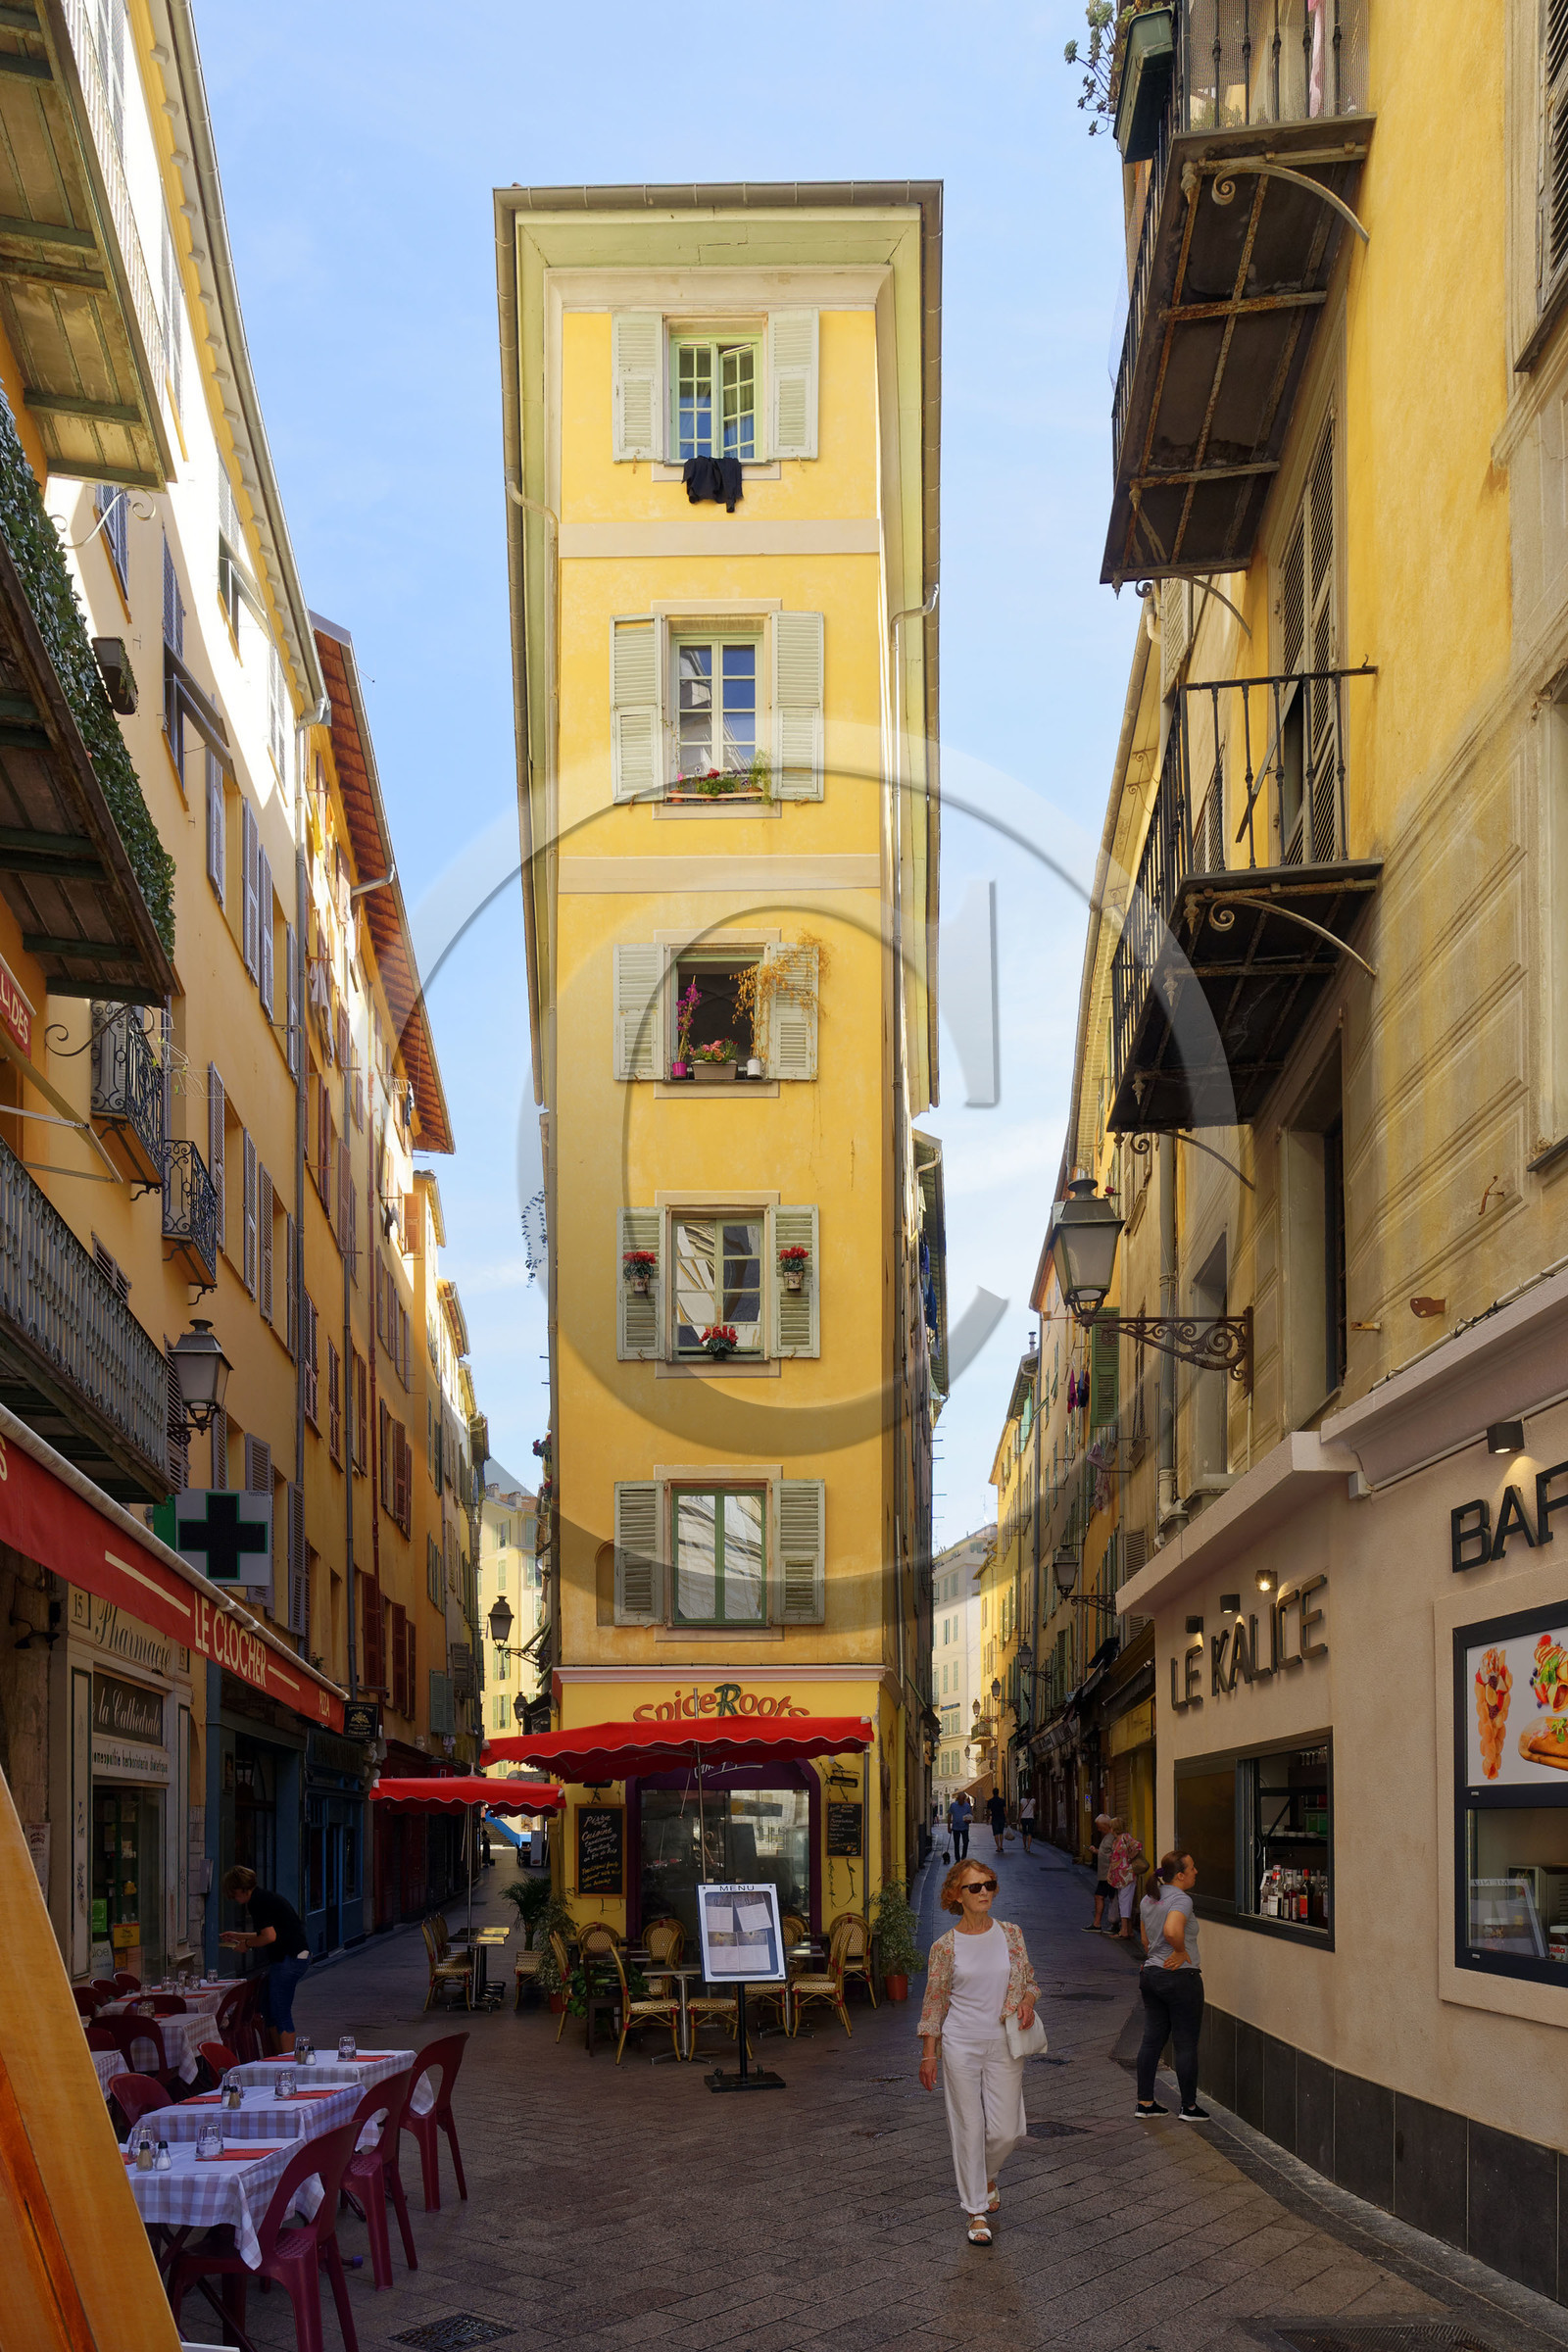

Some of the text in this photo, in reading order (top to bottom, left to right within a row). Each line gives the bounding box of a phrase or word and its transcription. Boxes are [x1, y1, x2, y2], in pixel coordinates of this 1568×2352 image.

[95, 1598, 171, 1670] Pharmacie
[194, 1591, 267, 1689] LE CLOCHER
[1170, 1574, 1329, 1710] LE KALICE
